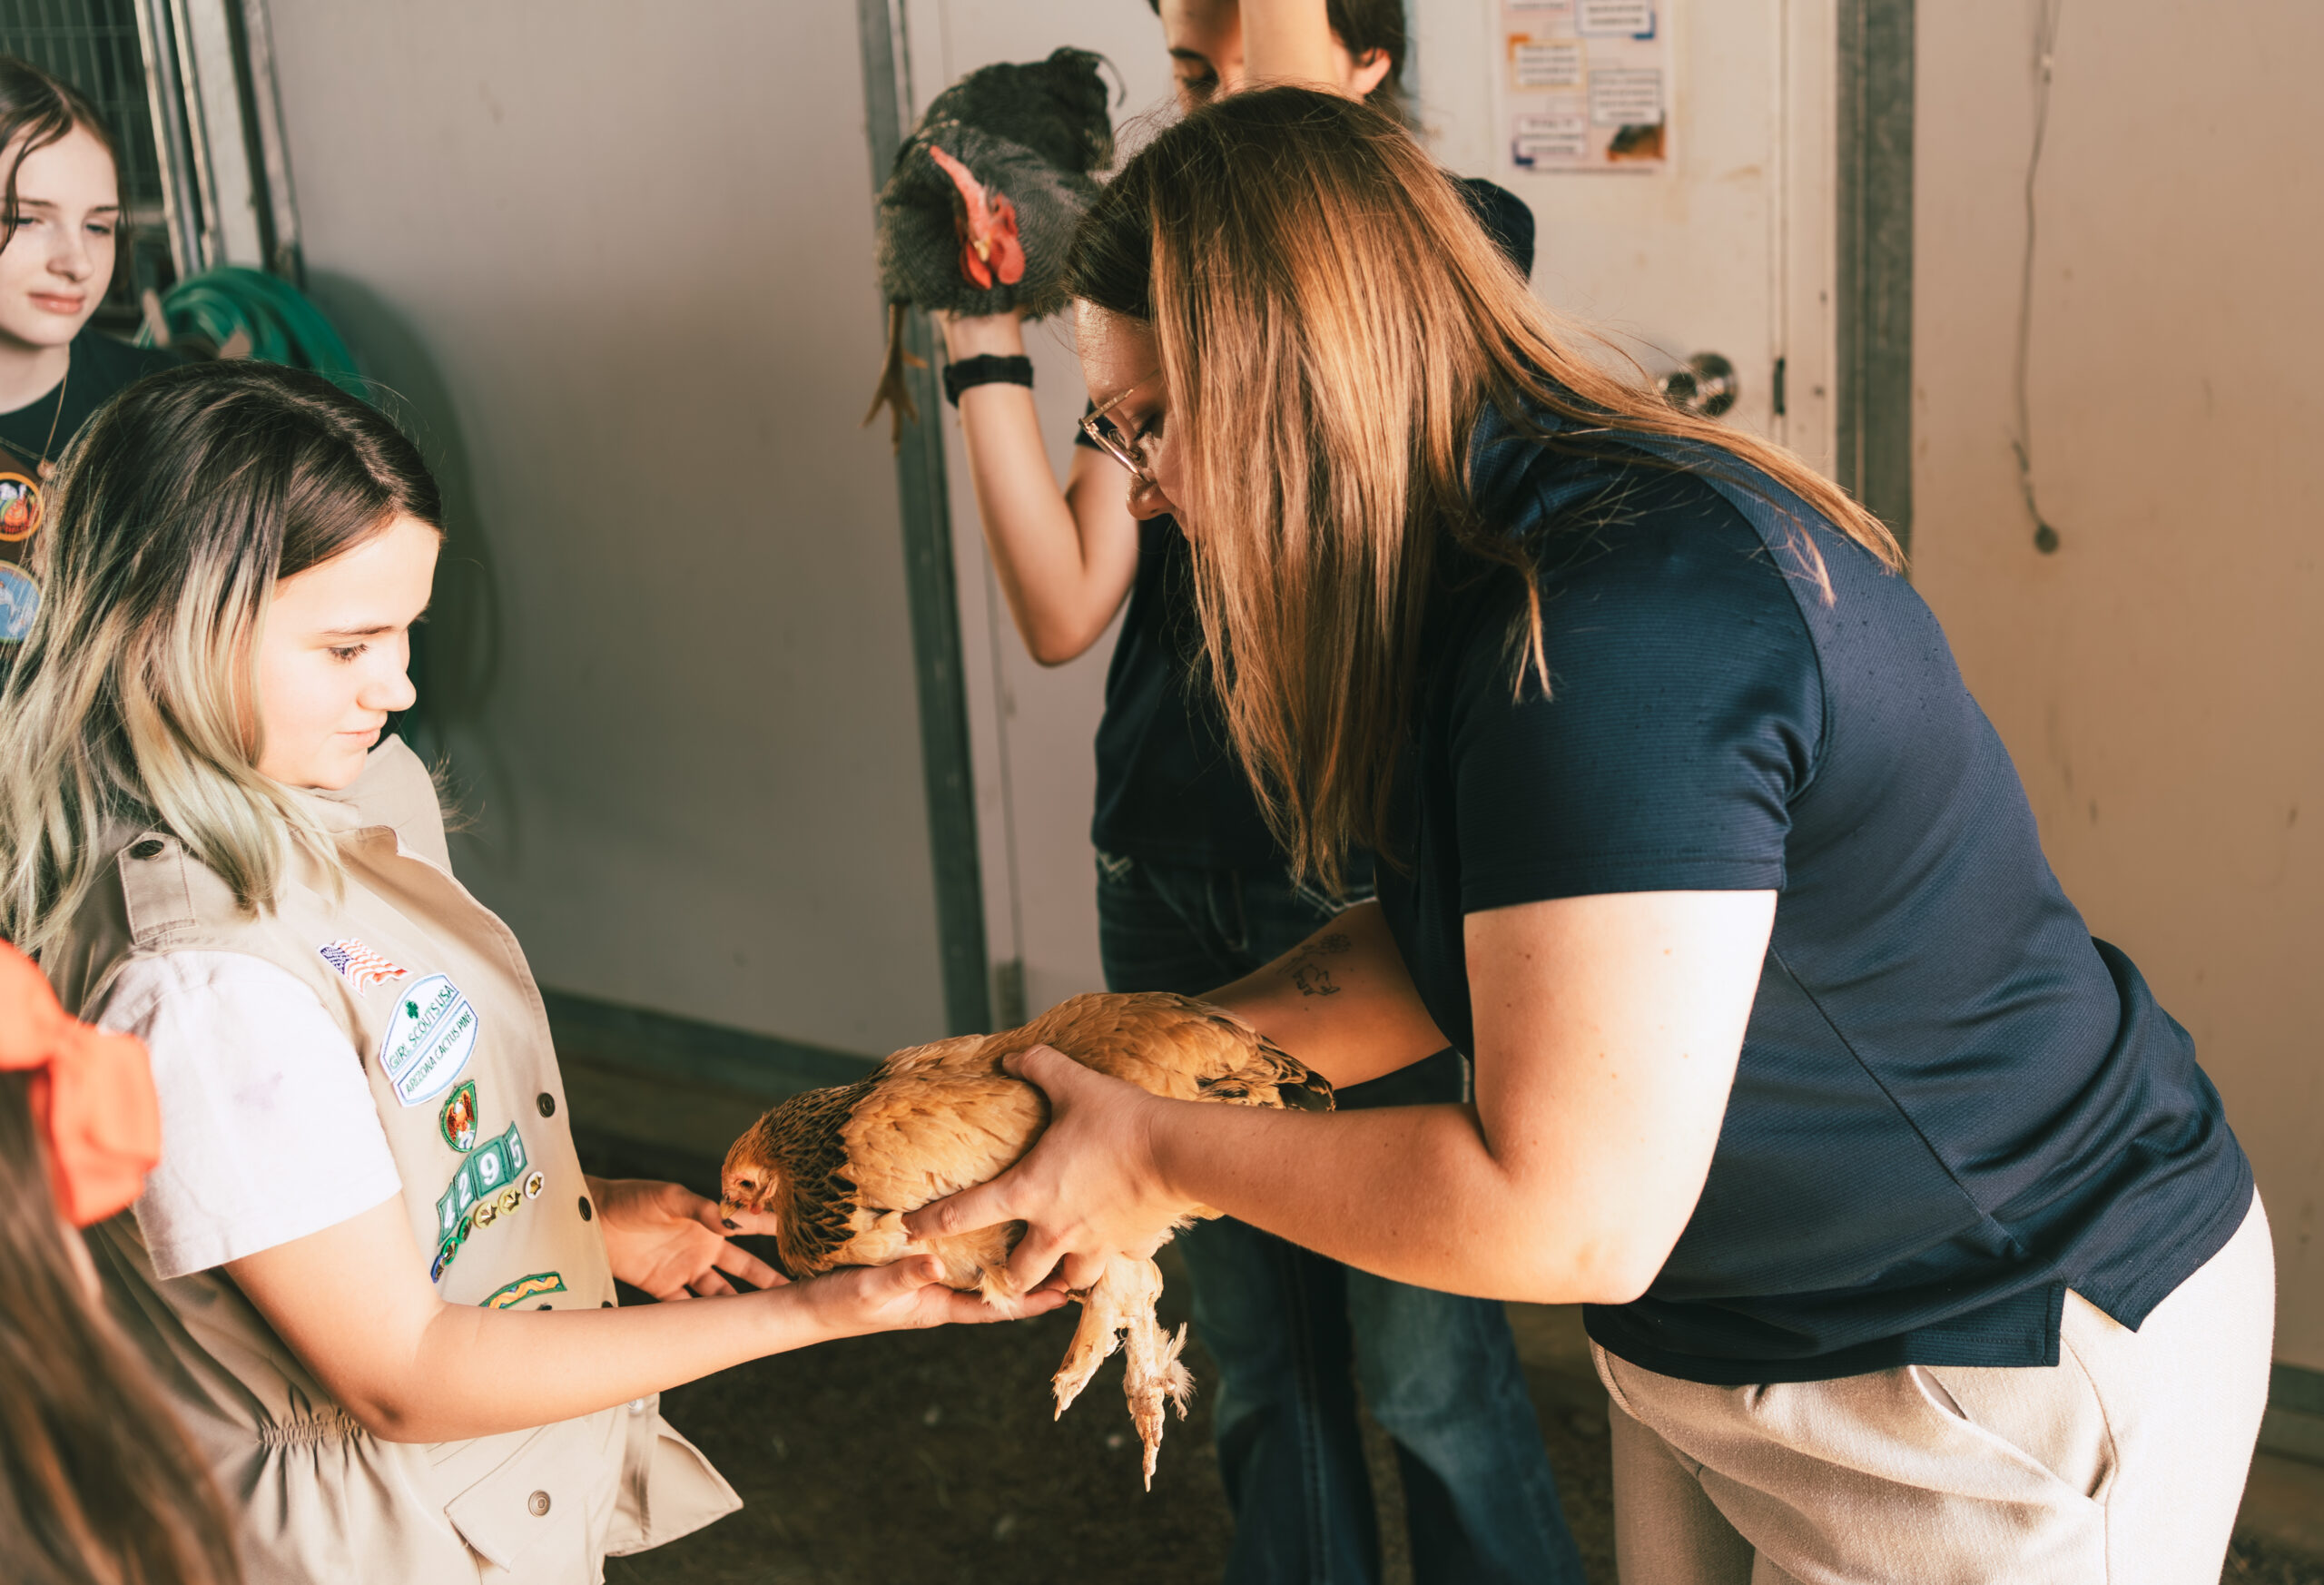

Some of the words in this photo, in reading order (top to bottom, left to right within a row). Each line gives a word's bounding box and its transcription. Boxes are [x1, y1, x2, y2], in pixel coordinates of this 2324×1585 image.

[405, 1057, 438, 1095] ARIZONA
[435, 1027, 460, 1060] CACTUS
[456, 1010, 473, 1033] PINE
[409, 1002, 440, 1048] SCOUTS
[435, 985, 455, 1009] USA
